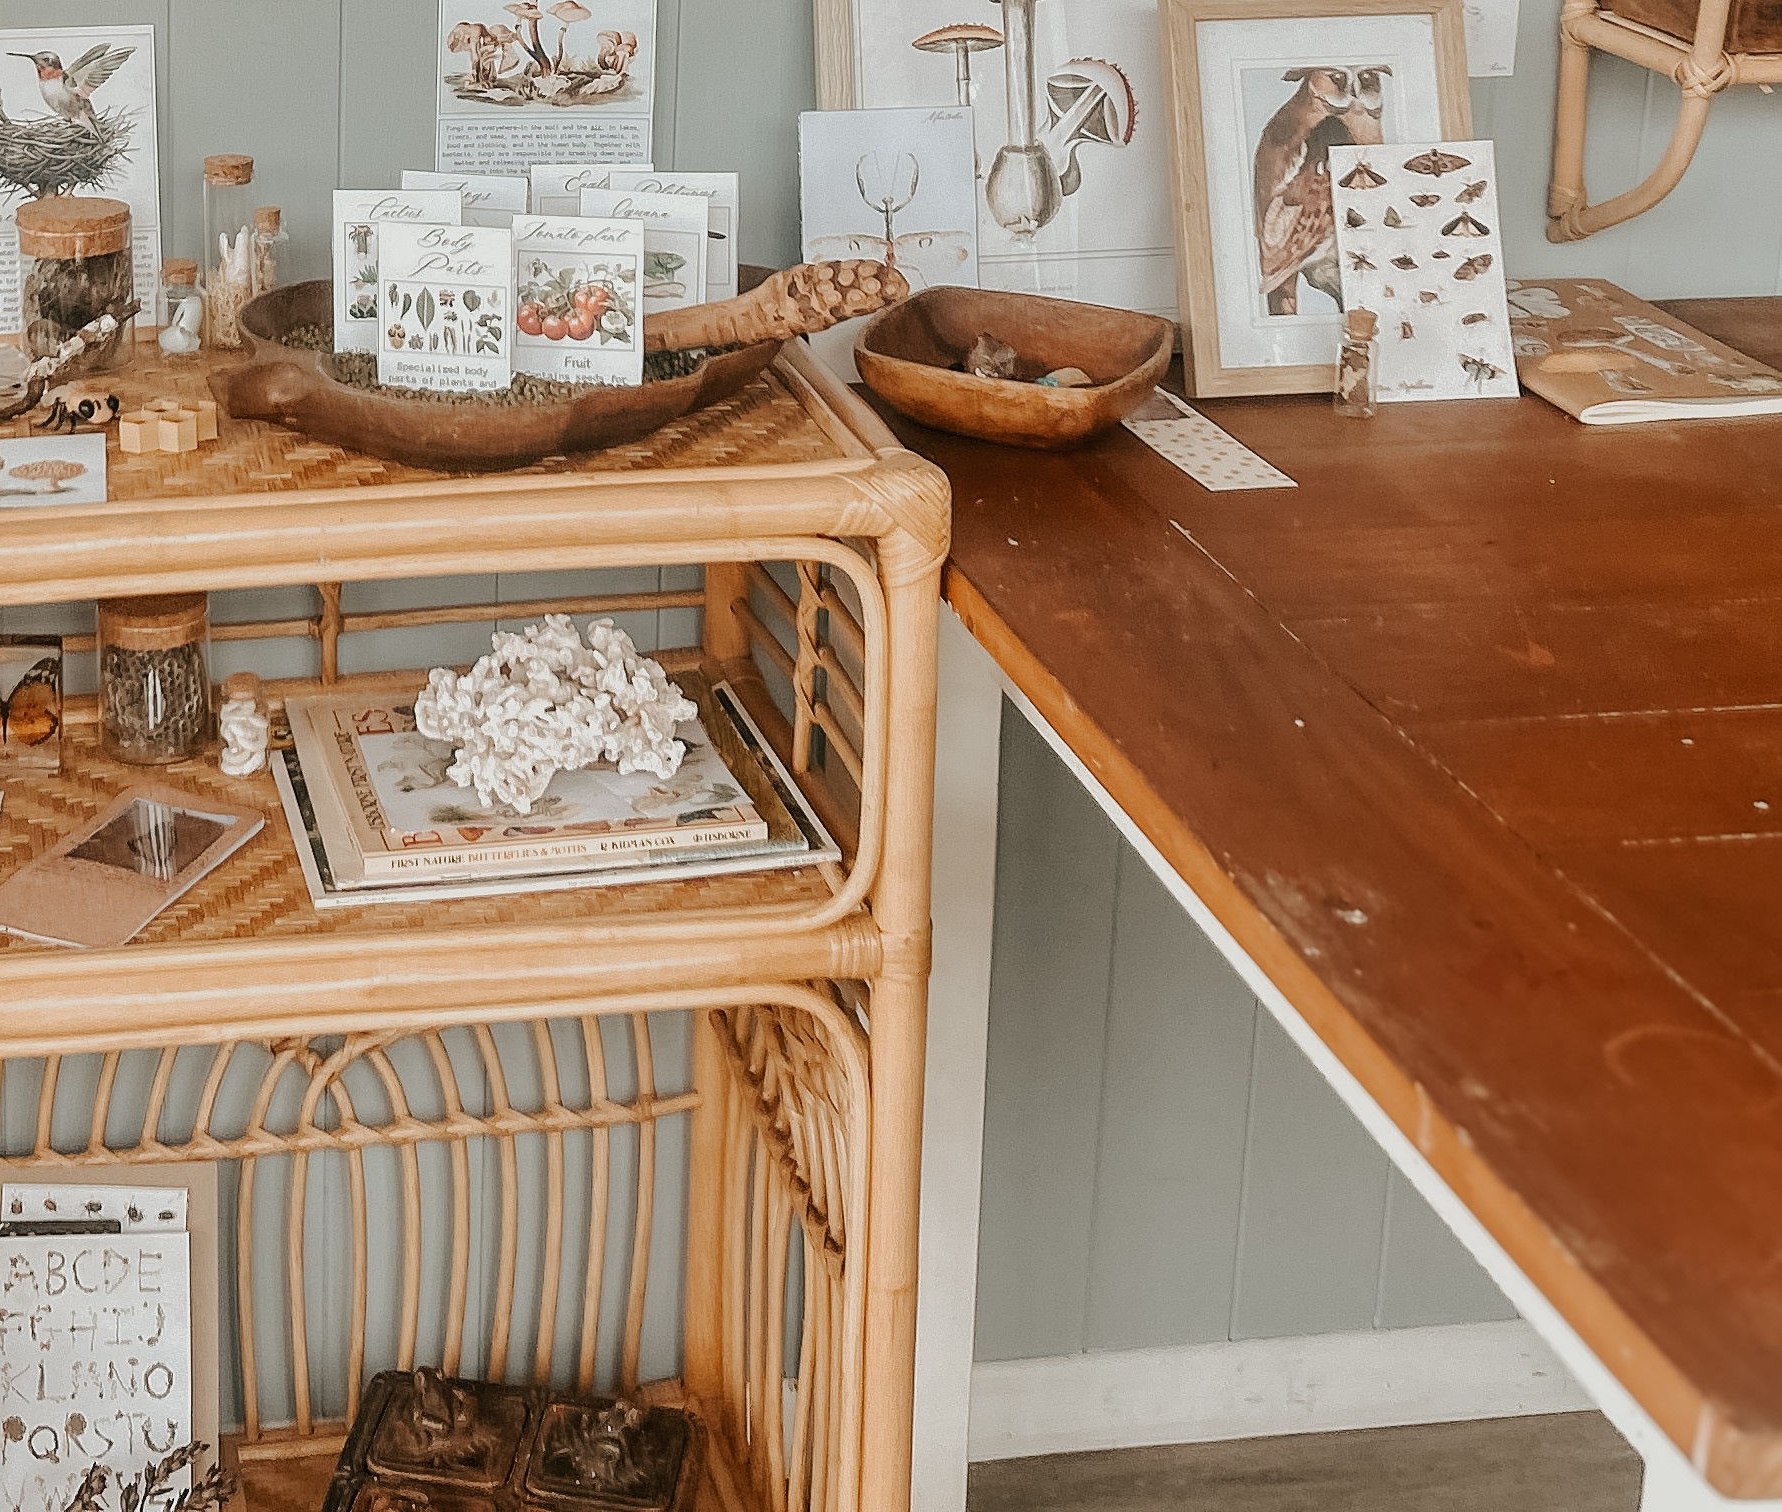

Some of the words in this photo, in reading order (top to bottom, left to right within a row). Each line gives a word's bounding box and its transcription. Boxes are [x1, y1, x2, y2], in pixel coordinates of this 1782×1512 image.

[417, 228, 475, 255] Body
[408, 252, 486, 278] Parts
[396, 361, 460, 375] Specialized
[465, 366, 489, 378] body
[564, 356, 592, 369] Fruit
[421, 375, 435, 386] of
[439, 376, 474, 388] plants
[479, 378, 498, 388] and
